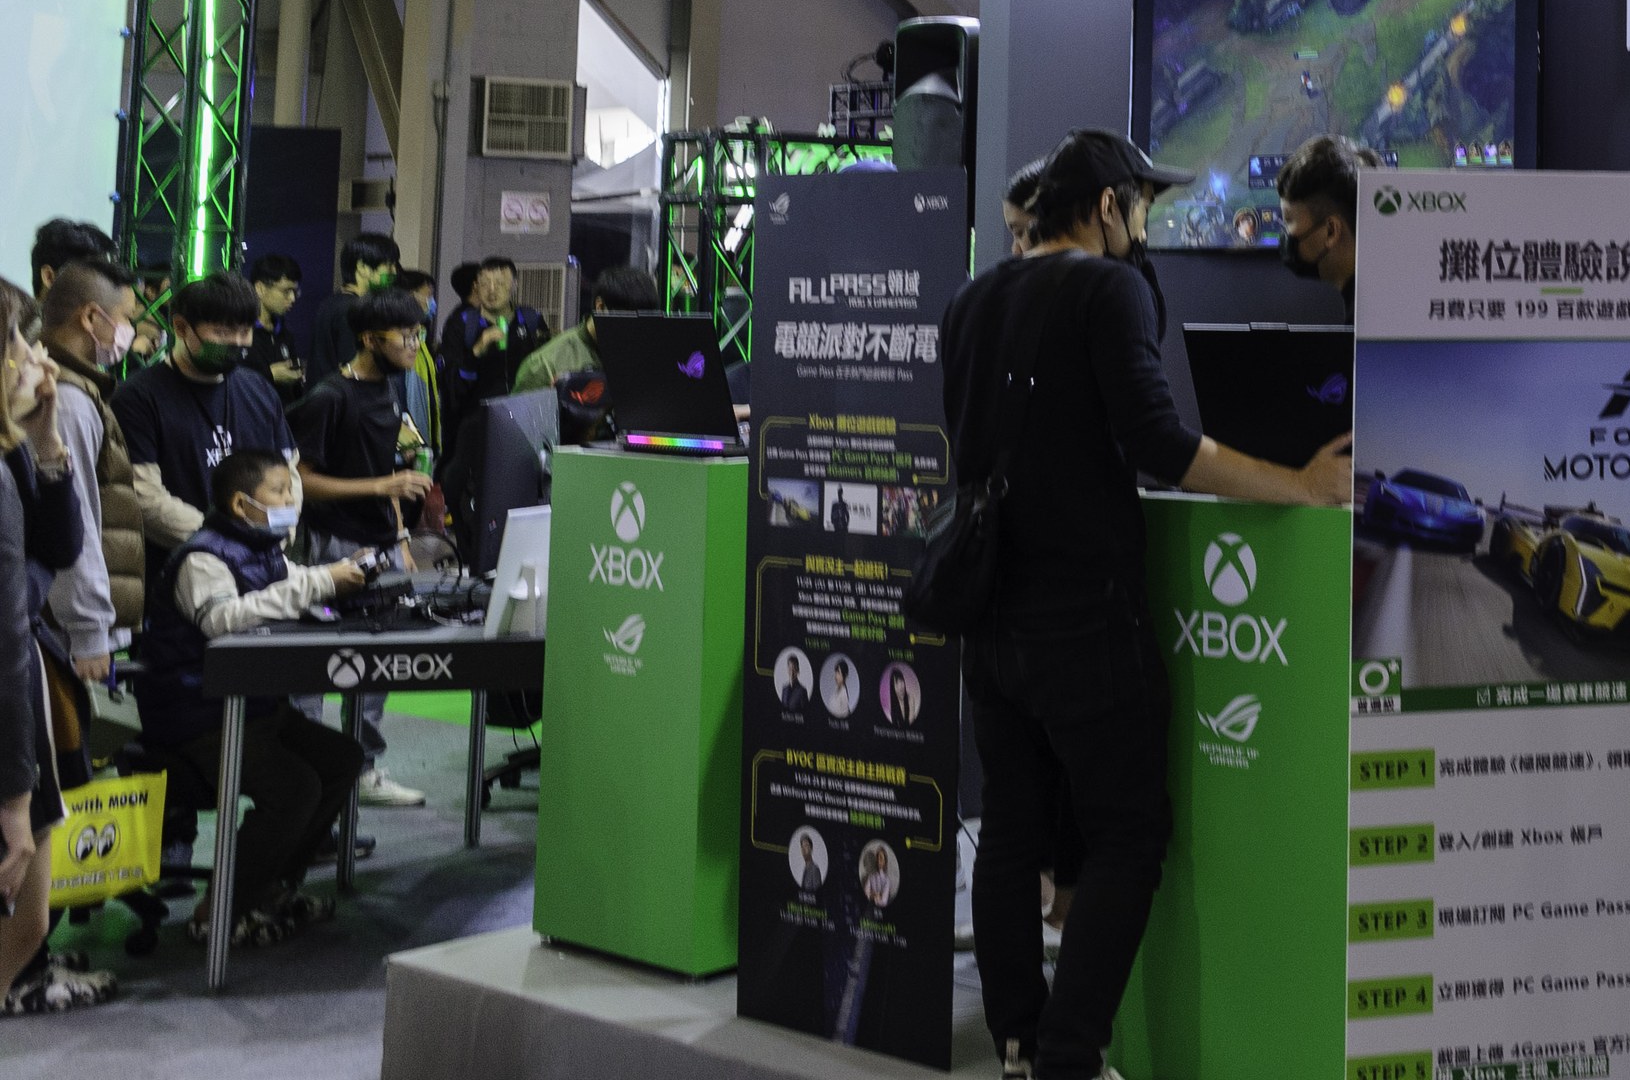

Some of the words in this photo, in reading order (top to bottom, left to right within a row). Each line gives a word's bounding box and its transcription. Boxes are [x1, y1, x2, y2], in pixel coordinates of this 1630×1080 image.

[1406, 191, 1467, 213] XBOX
[1515, 298, 1549, 319] 199
[588, 542, 665, 593] XBOX
[1173, 607, 1289, 667] XBOX
[371, 652, 454, 682] XBOX
[1360, 759, 1409, 782] STEP
[1419, 758, 1427, 778] 1
[72, 795, 103, 813] with
[109, 790, 149, 809] MOON
[1359, 834, 1409, 858] STEP
[1417, 833, 1428, 853] 2
[1521, 827, 1564, 847] Xbox
[1358, 908, 1408, 934] STEP
[1417, 908, 1428, 931] 3
[1512, 901, 1535, 921] PC
[1541, 899, 1590, 920] Game
[1357, 986, 1407, 1011] STEP
[1415, 984, 1427, 1007] 4
[1512, 975, 1535, 995] PC
[1541, 973, 1590, 994] Game
[1357, 1060, 1407, 1080] STEP
[1511, 1039, 1587, 1059] 4Gamers
